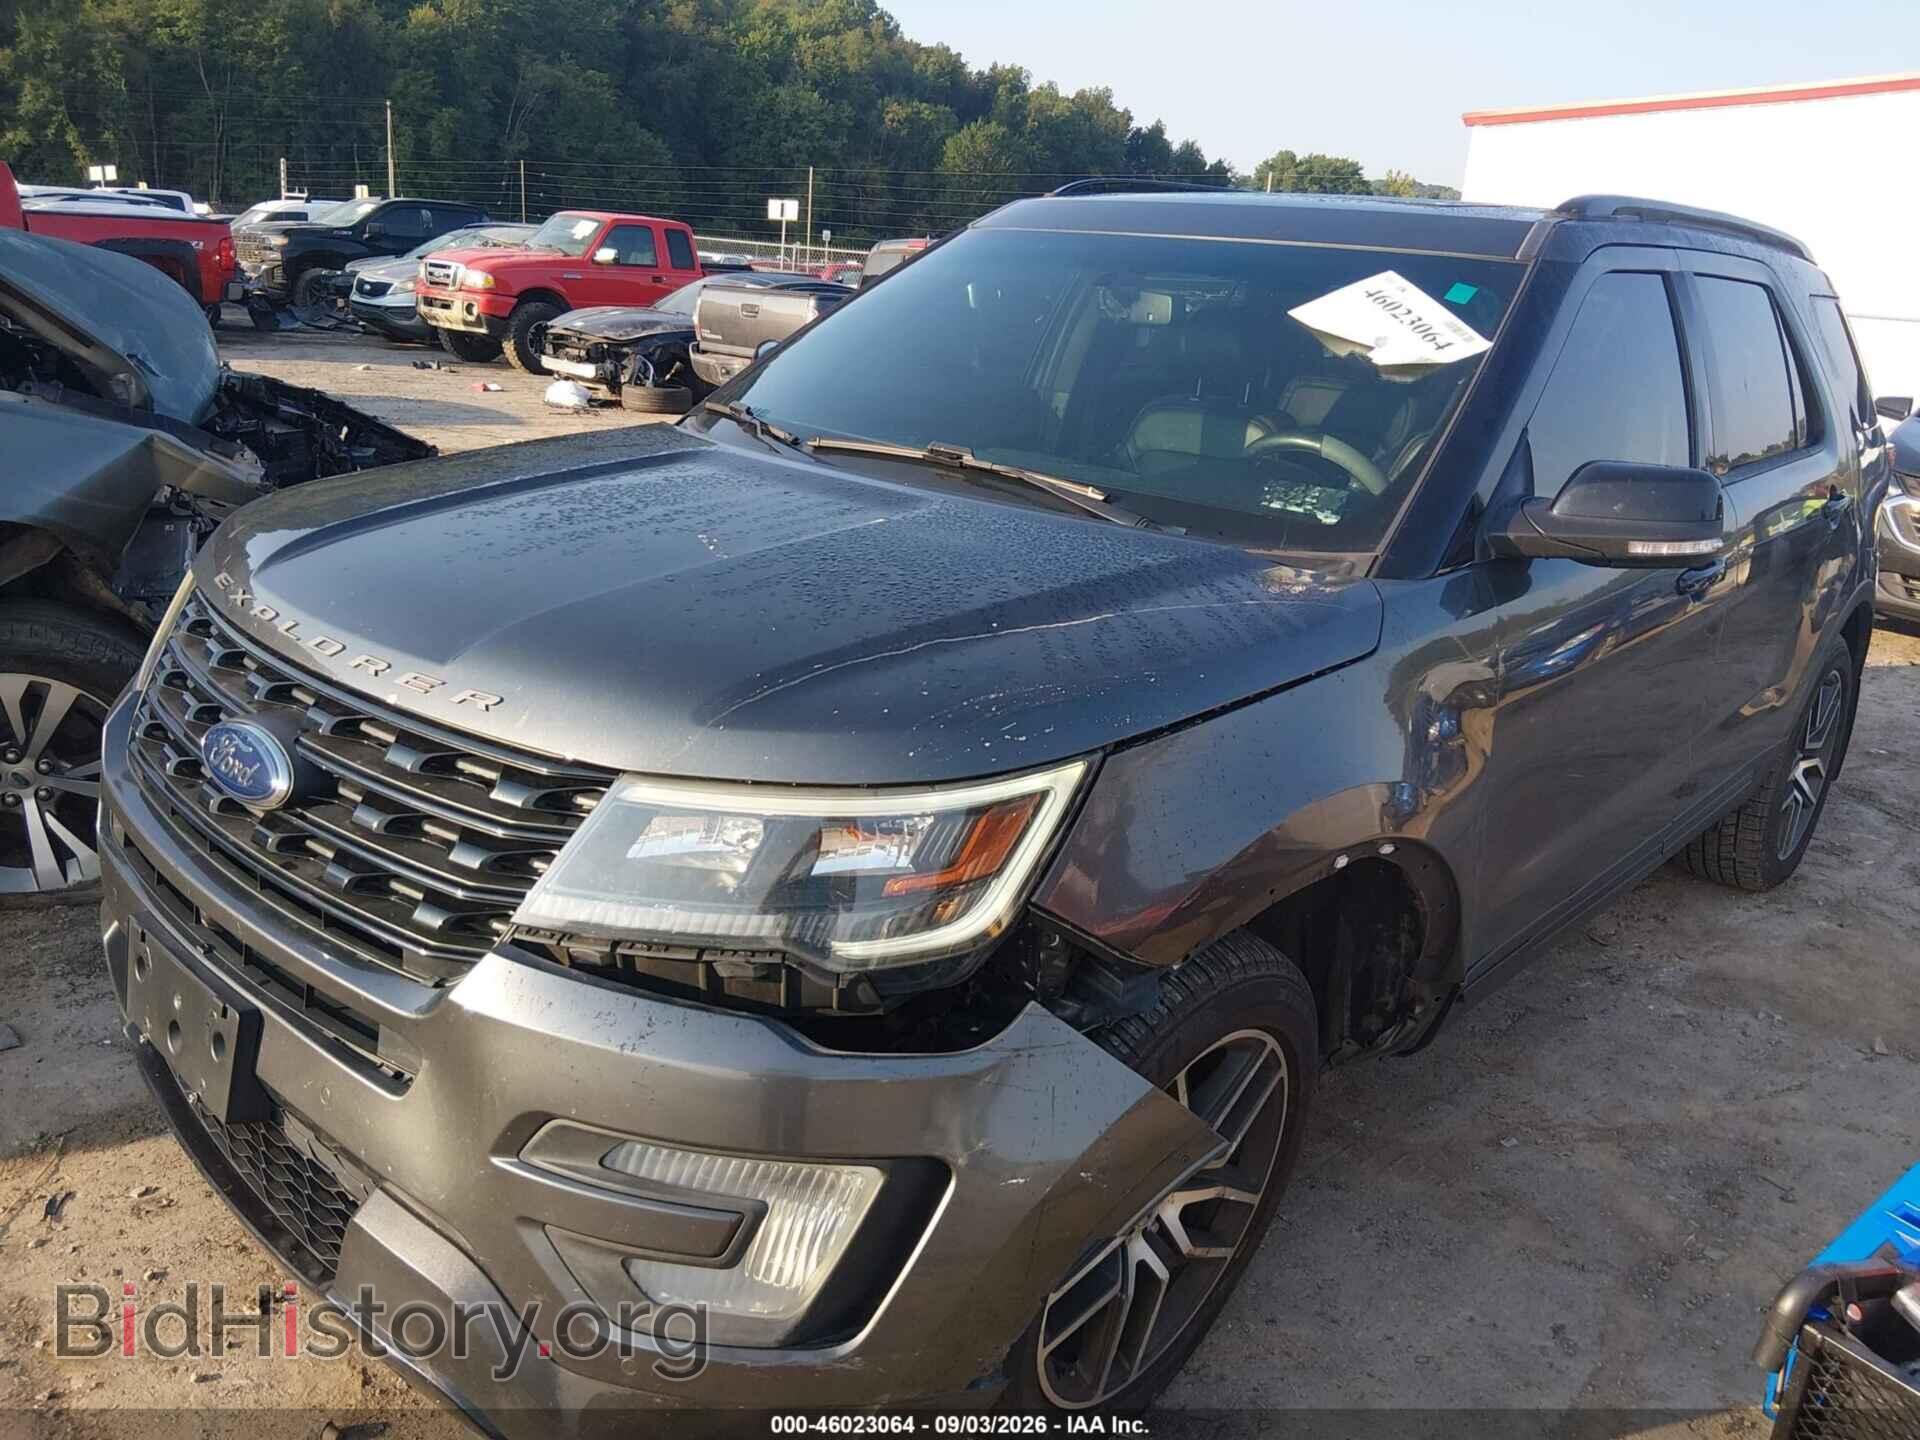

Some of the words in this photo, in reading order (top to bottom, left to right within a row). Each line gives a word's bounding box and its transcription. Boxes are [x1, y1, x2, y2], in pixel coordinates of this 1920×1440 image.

[1364, 288, 1454, 351] 46023064
[213, 571, 505, 712] EXPLORER
[207, 733, 261, 788] Ford
